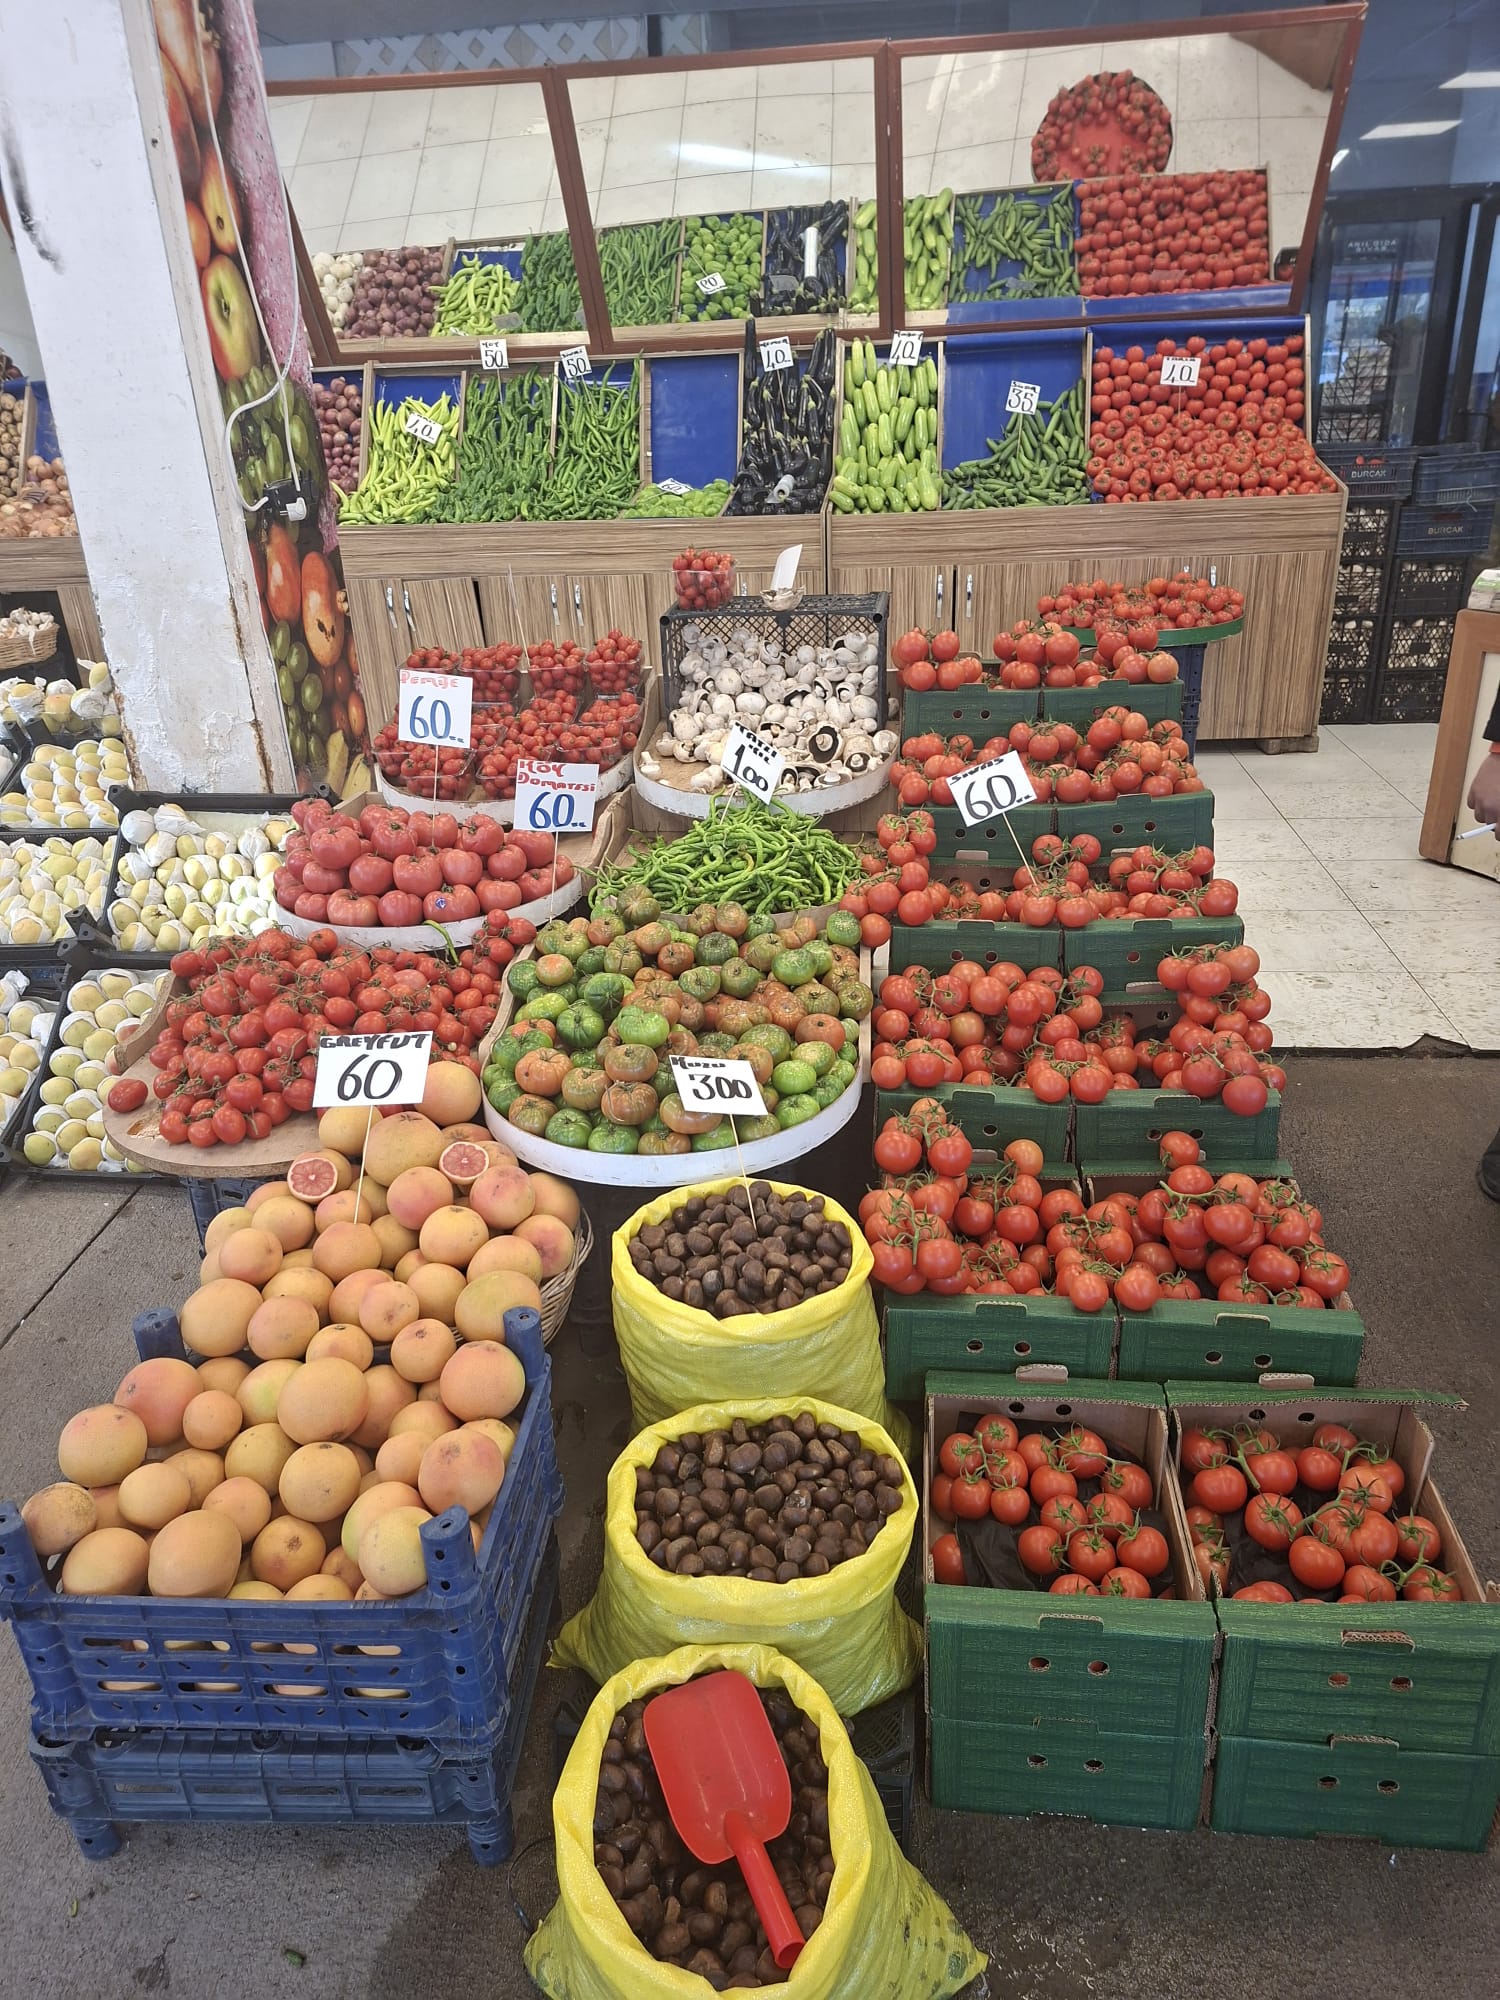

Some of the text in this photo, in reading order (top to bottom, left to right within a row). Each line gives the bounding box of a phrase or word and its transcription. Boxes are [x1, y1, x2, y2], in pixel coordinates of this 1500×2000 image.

[485, 350, 503, 368] 50
[567, 358, 587, 377] 50
[1008, 388, 1033, 412] 35
[409, 695, 451, 739] 60
[529, 791, 575, 829] 60
[965, 774, 1017, 820] 60
[320, 1033, 431, 1050] GREYFUT
[337, 1053, 403, 1101] 60
[688, 1073, 753, 1100] 300
